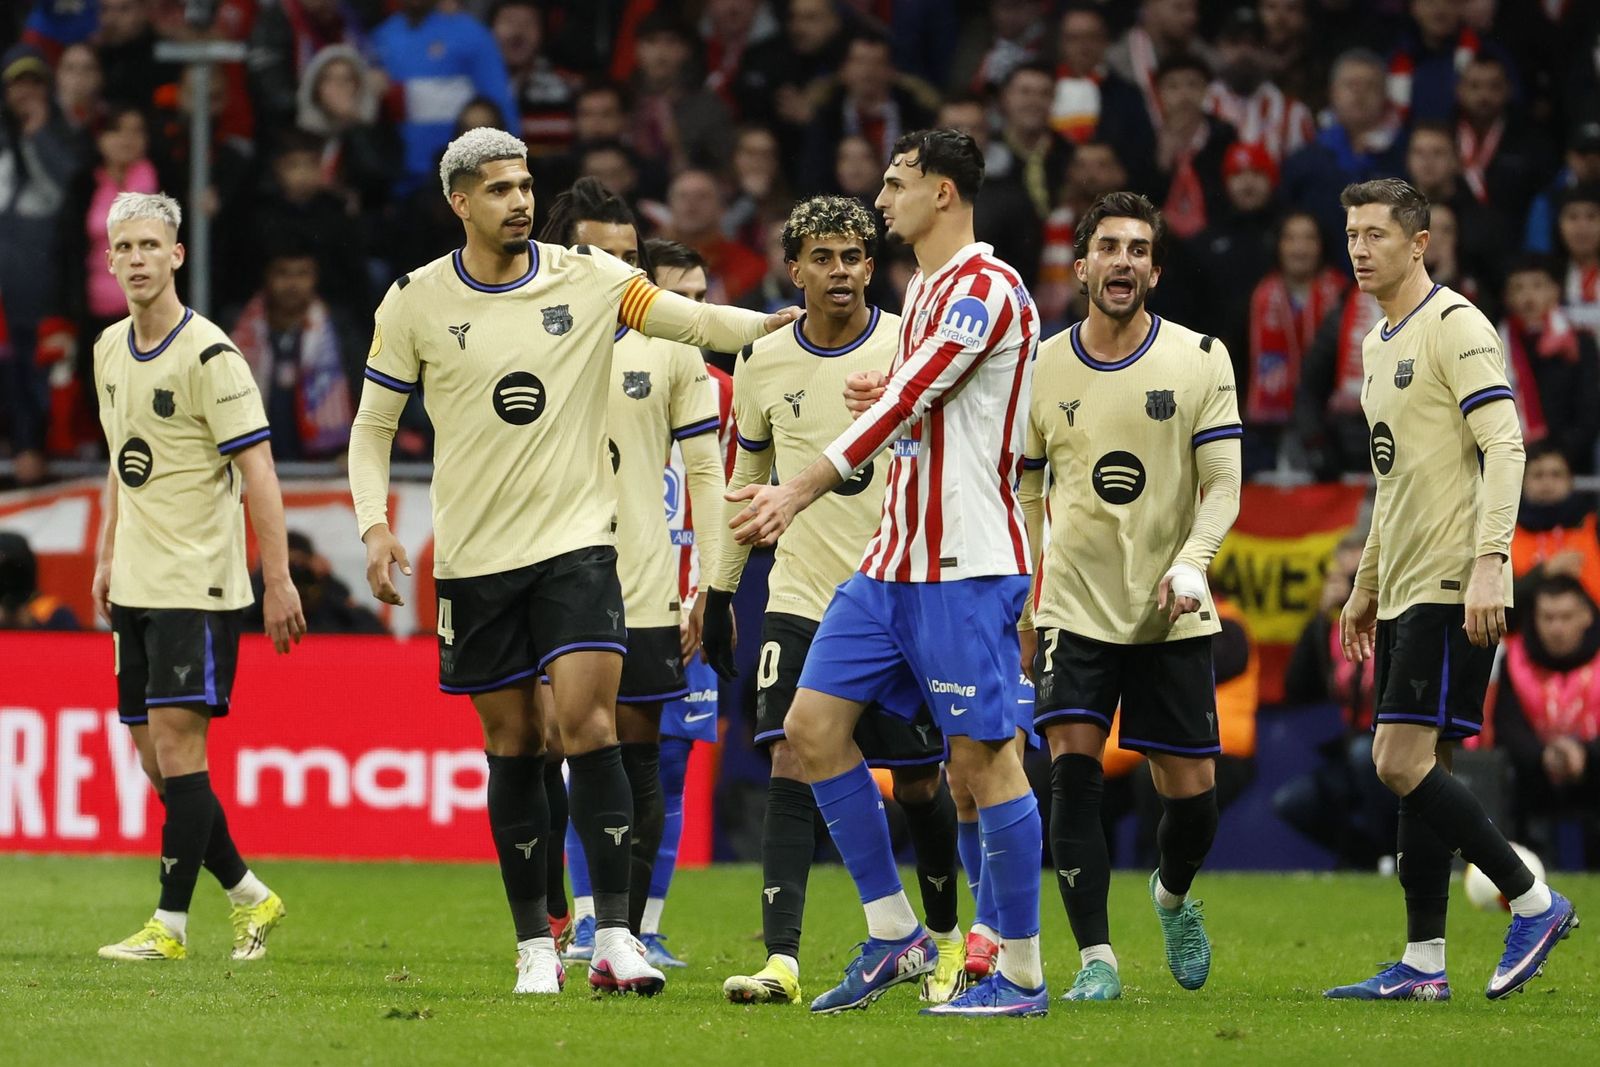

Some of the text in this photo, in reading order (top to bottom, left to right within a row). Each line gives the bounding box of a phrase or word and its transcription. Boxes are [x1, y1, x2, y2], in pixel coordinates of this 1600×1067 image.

[940, 327, 981, 349] kraken
[672, 531, 693, 545] AIR
[437, 597, 455, 646] 4
[1043, 628, 1060, 673] 7
[0, 706, 150, 840] REY
[236, 746, 489, 825] map
